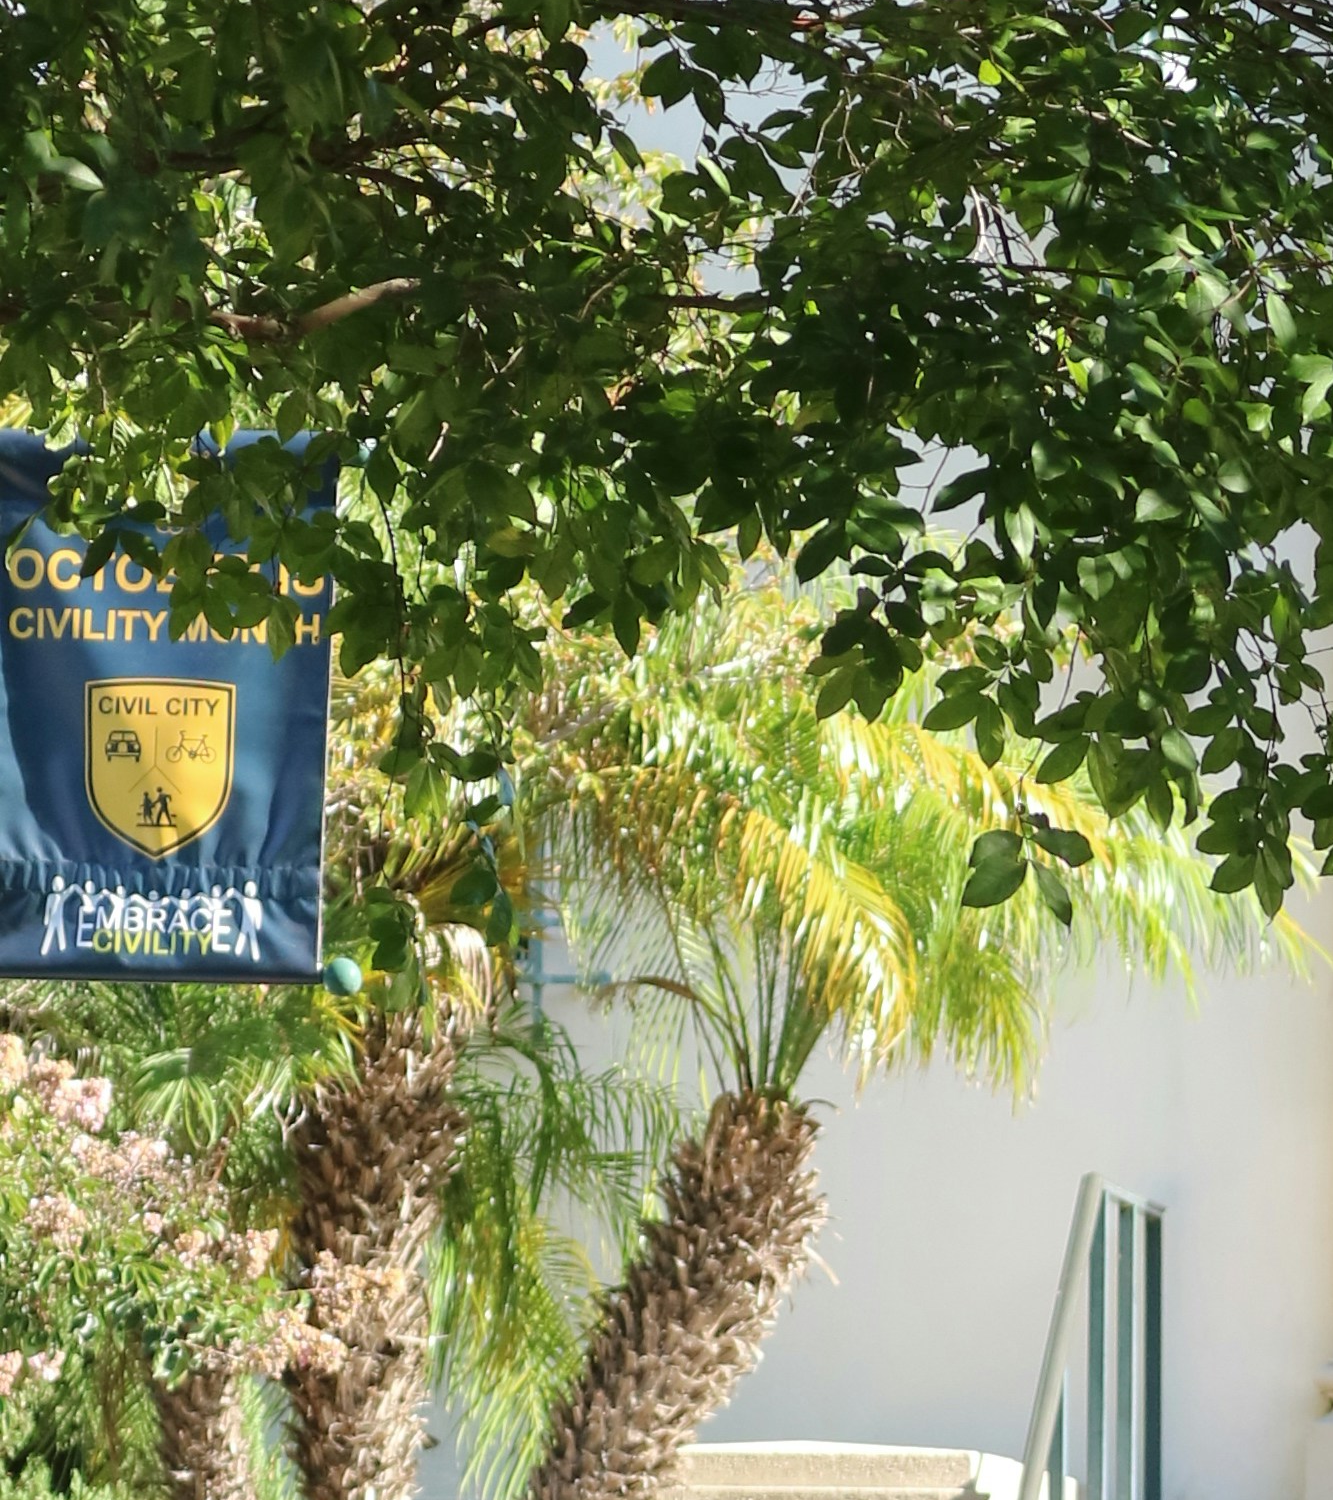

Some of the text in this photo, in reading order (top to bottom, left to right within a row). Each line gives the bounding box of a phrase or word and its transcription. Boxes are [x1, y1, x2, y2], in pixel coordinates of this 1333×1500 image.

[8, 548, 260, 595] OCTO
[8, 606, 321, 645] CIVILITY MNH
[98, 696, 220, 717] CIVIL CITY
[75, 905, 232, 952] EMBRACE
[93, 930, 212, 956] CIVILITY
